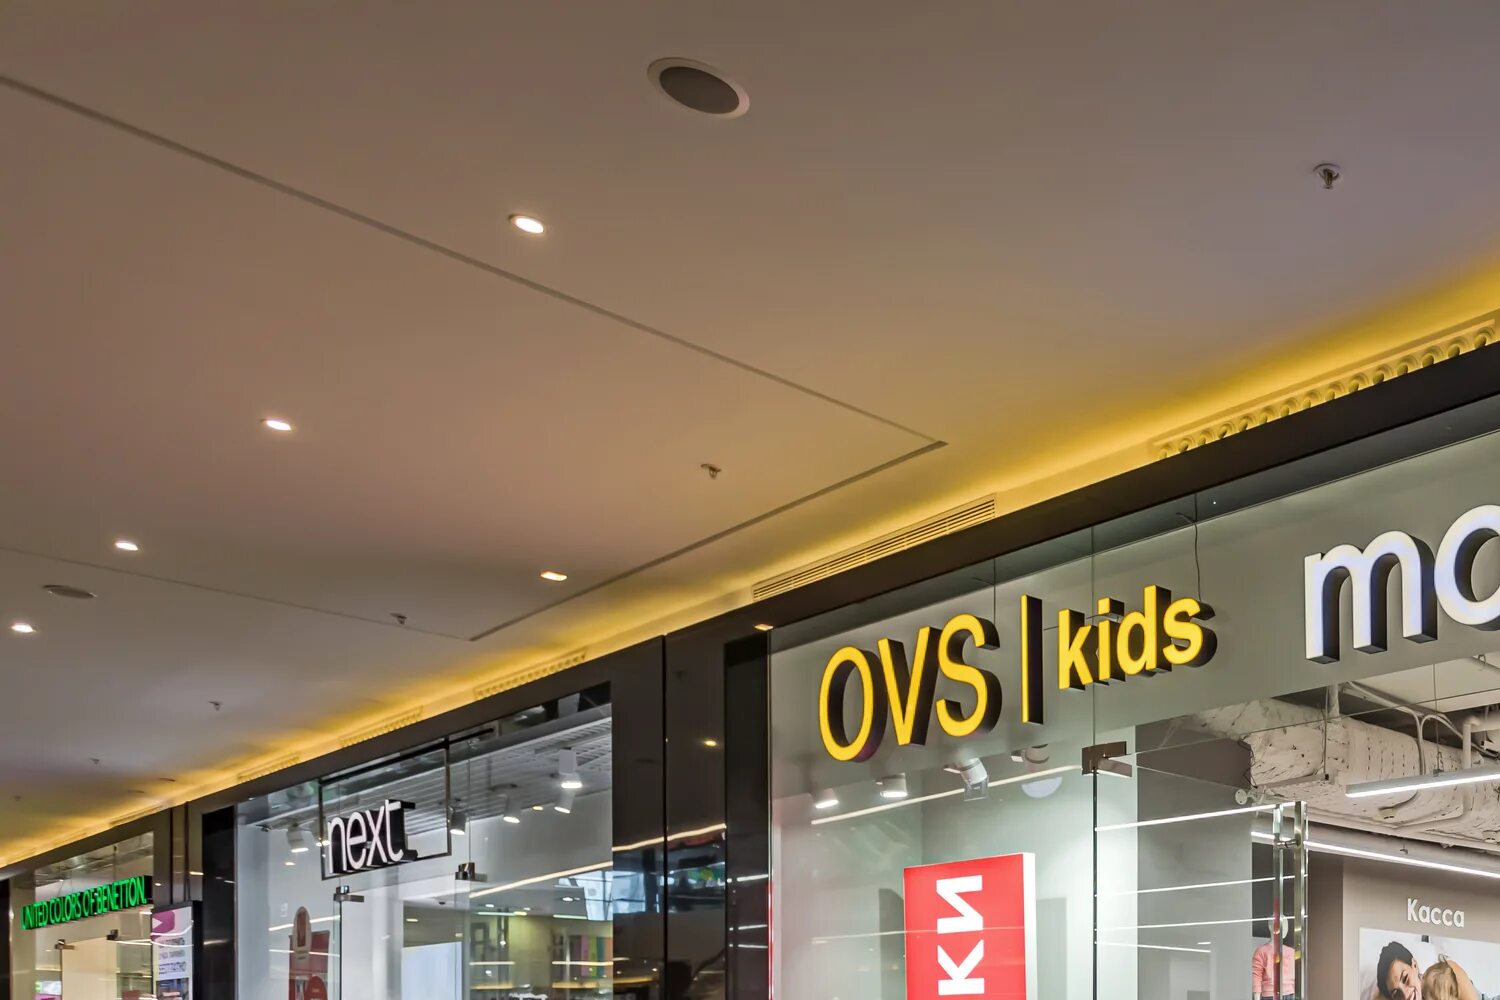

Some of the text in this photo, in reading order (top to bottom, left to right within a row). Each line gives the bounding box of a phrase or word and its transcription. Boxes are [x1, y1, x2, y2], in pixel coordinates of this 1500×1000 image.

[819, 583, 1207, 762] OVS kids
[327, 799, 404, 874] next
[21, 901, 49, 930] UNITED
[50, 893, 82, 924] COLORS
[82, 889, 96, 917] OF
[1407, 898, 1465, 928] Касса
